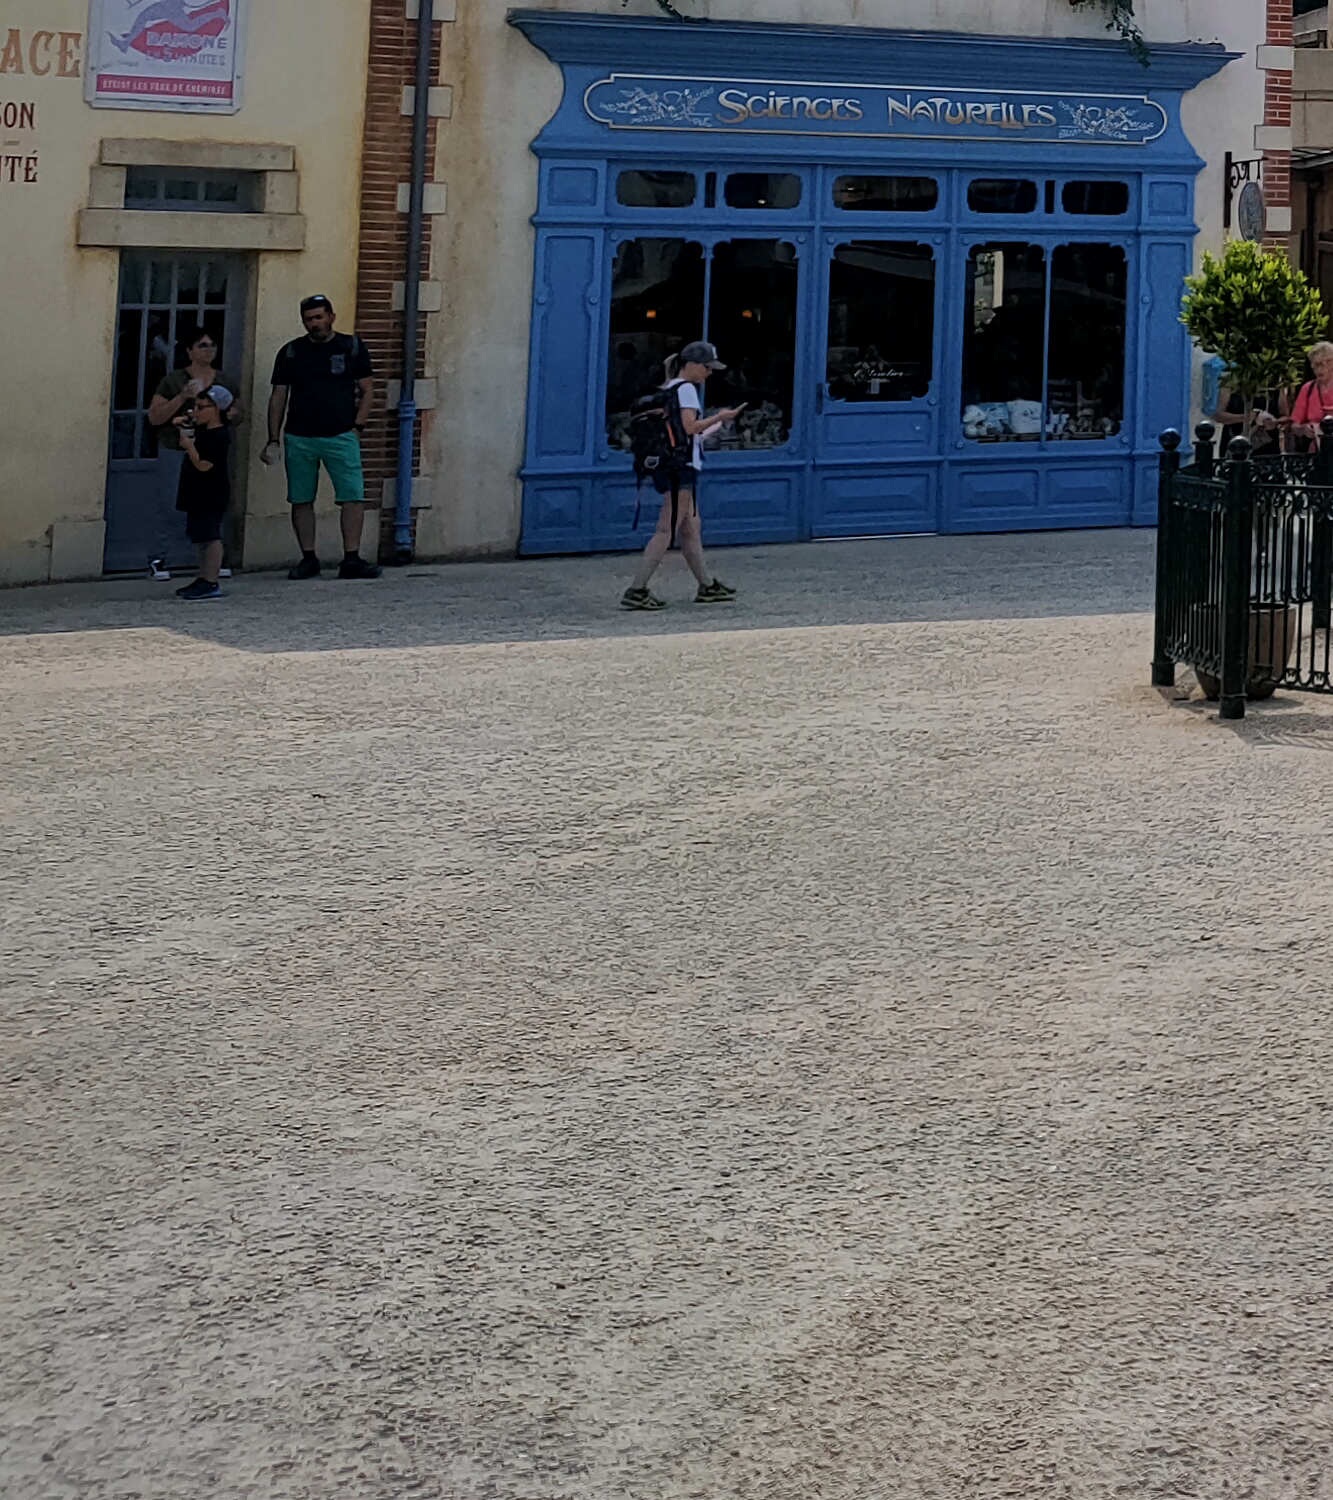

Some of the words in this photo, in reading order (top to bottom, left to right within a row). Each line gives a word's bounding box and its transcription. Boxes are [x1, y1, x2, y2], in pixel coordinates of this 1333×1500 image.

[146, 31, 228, 49] RAMONE
[0, 101, 35, 129] ON
[887, 94, 1057, 129] NATURELLES
[0, 150, 39, 183] TÉ
